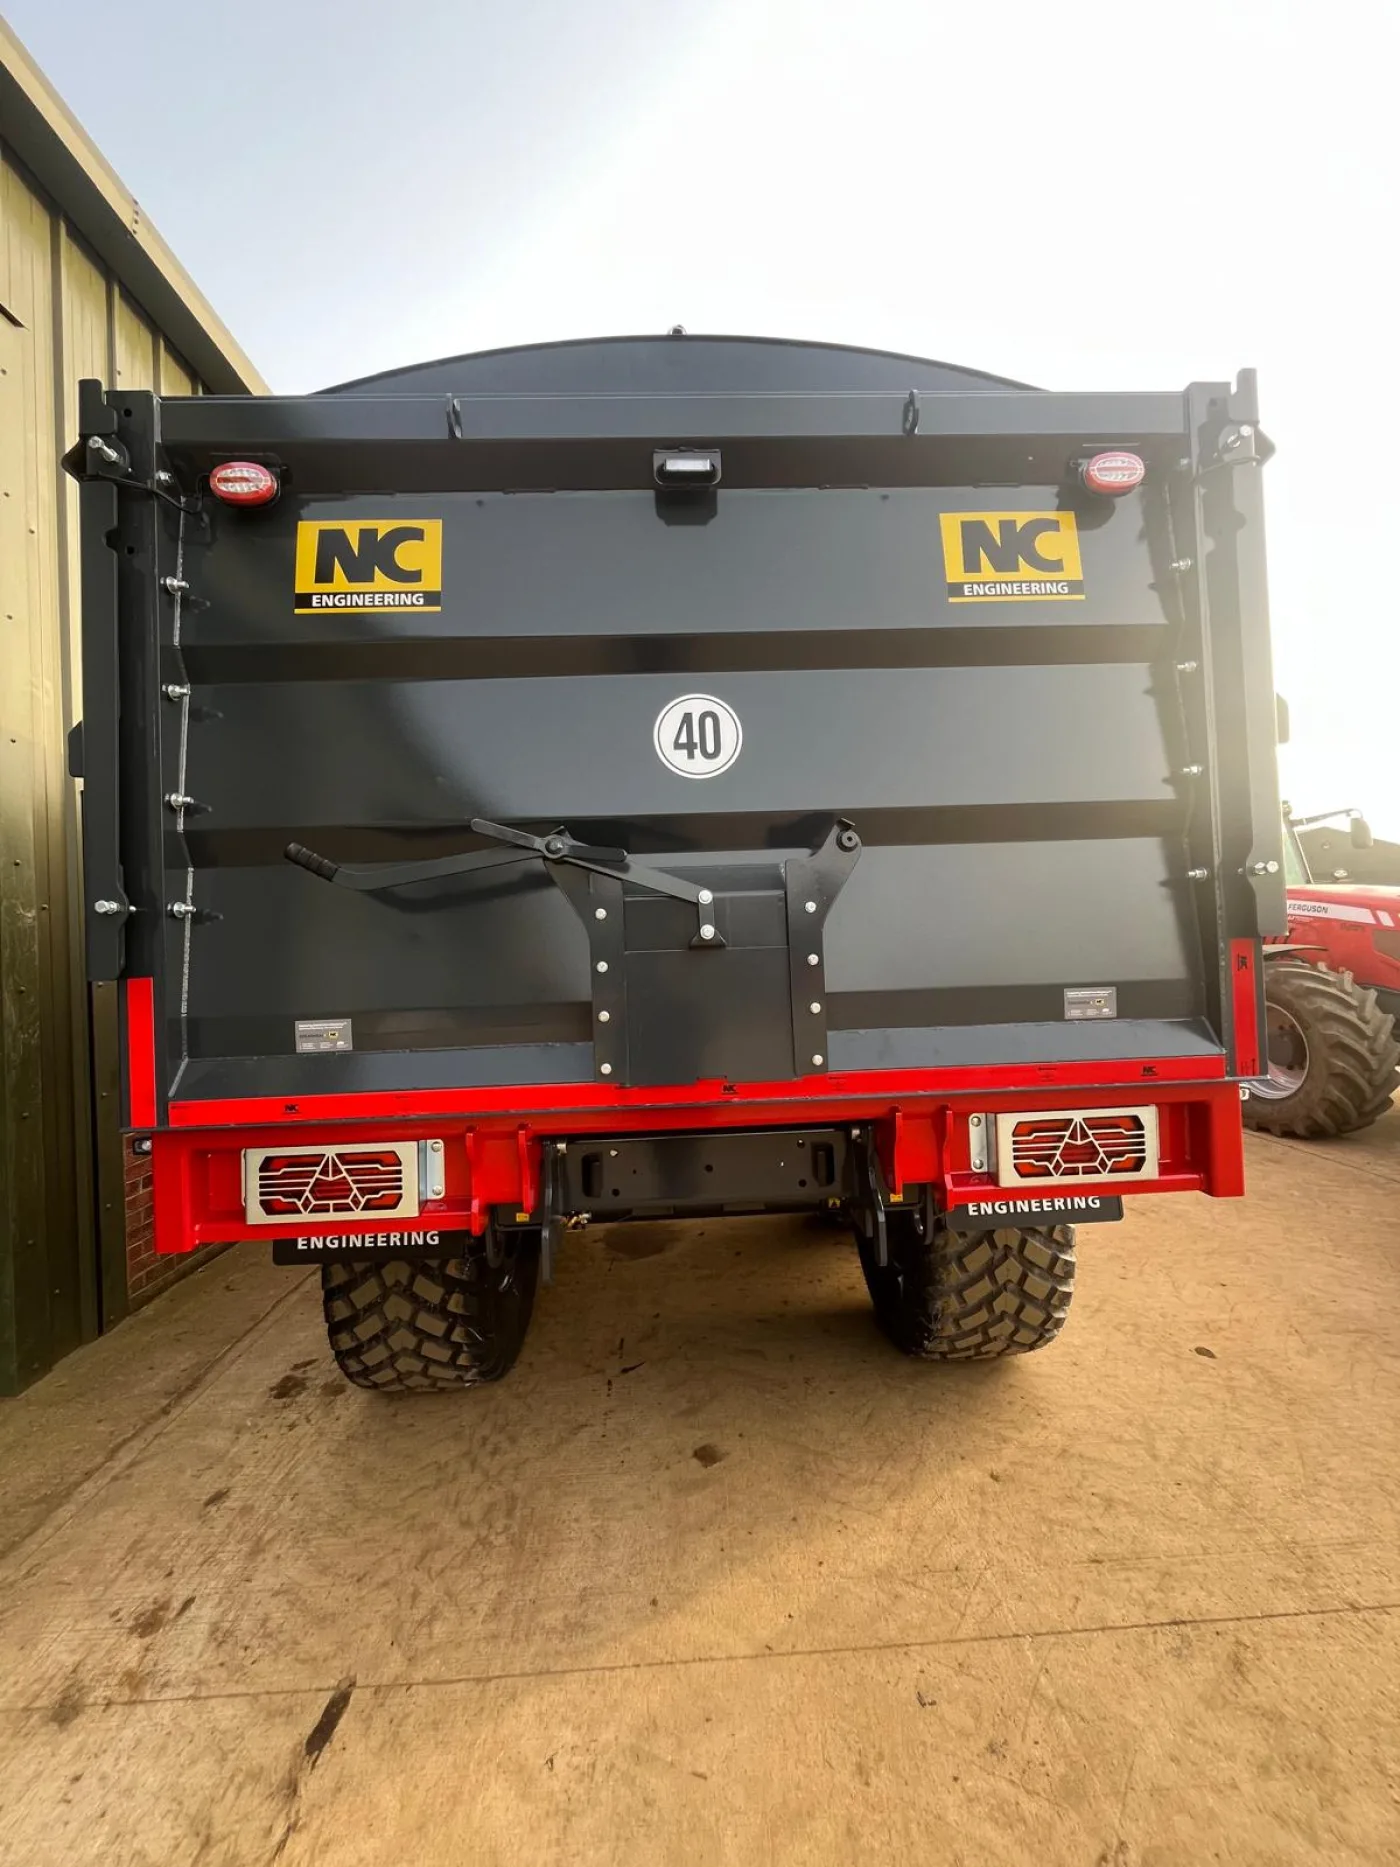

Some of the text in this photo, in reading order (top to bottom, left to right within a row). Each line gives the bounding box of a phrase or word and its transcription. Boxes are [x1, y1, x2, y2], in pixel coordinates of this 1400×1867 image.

[314, 526, 425, 584] NC
[960, 518, 1065, 574] NC
[963, 582, 1069, 596] ENGINEERING
[311, 593, 425, 608] ENGINEERING
[673, 710, 722, 760] 40
[1288, 903, 1329, 914] FERGUSON
[968, 1195, 1101, 1216] ENGINEERING
[297, 1231, 440, 1250] ENGINEERING
